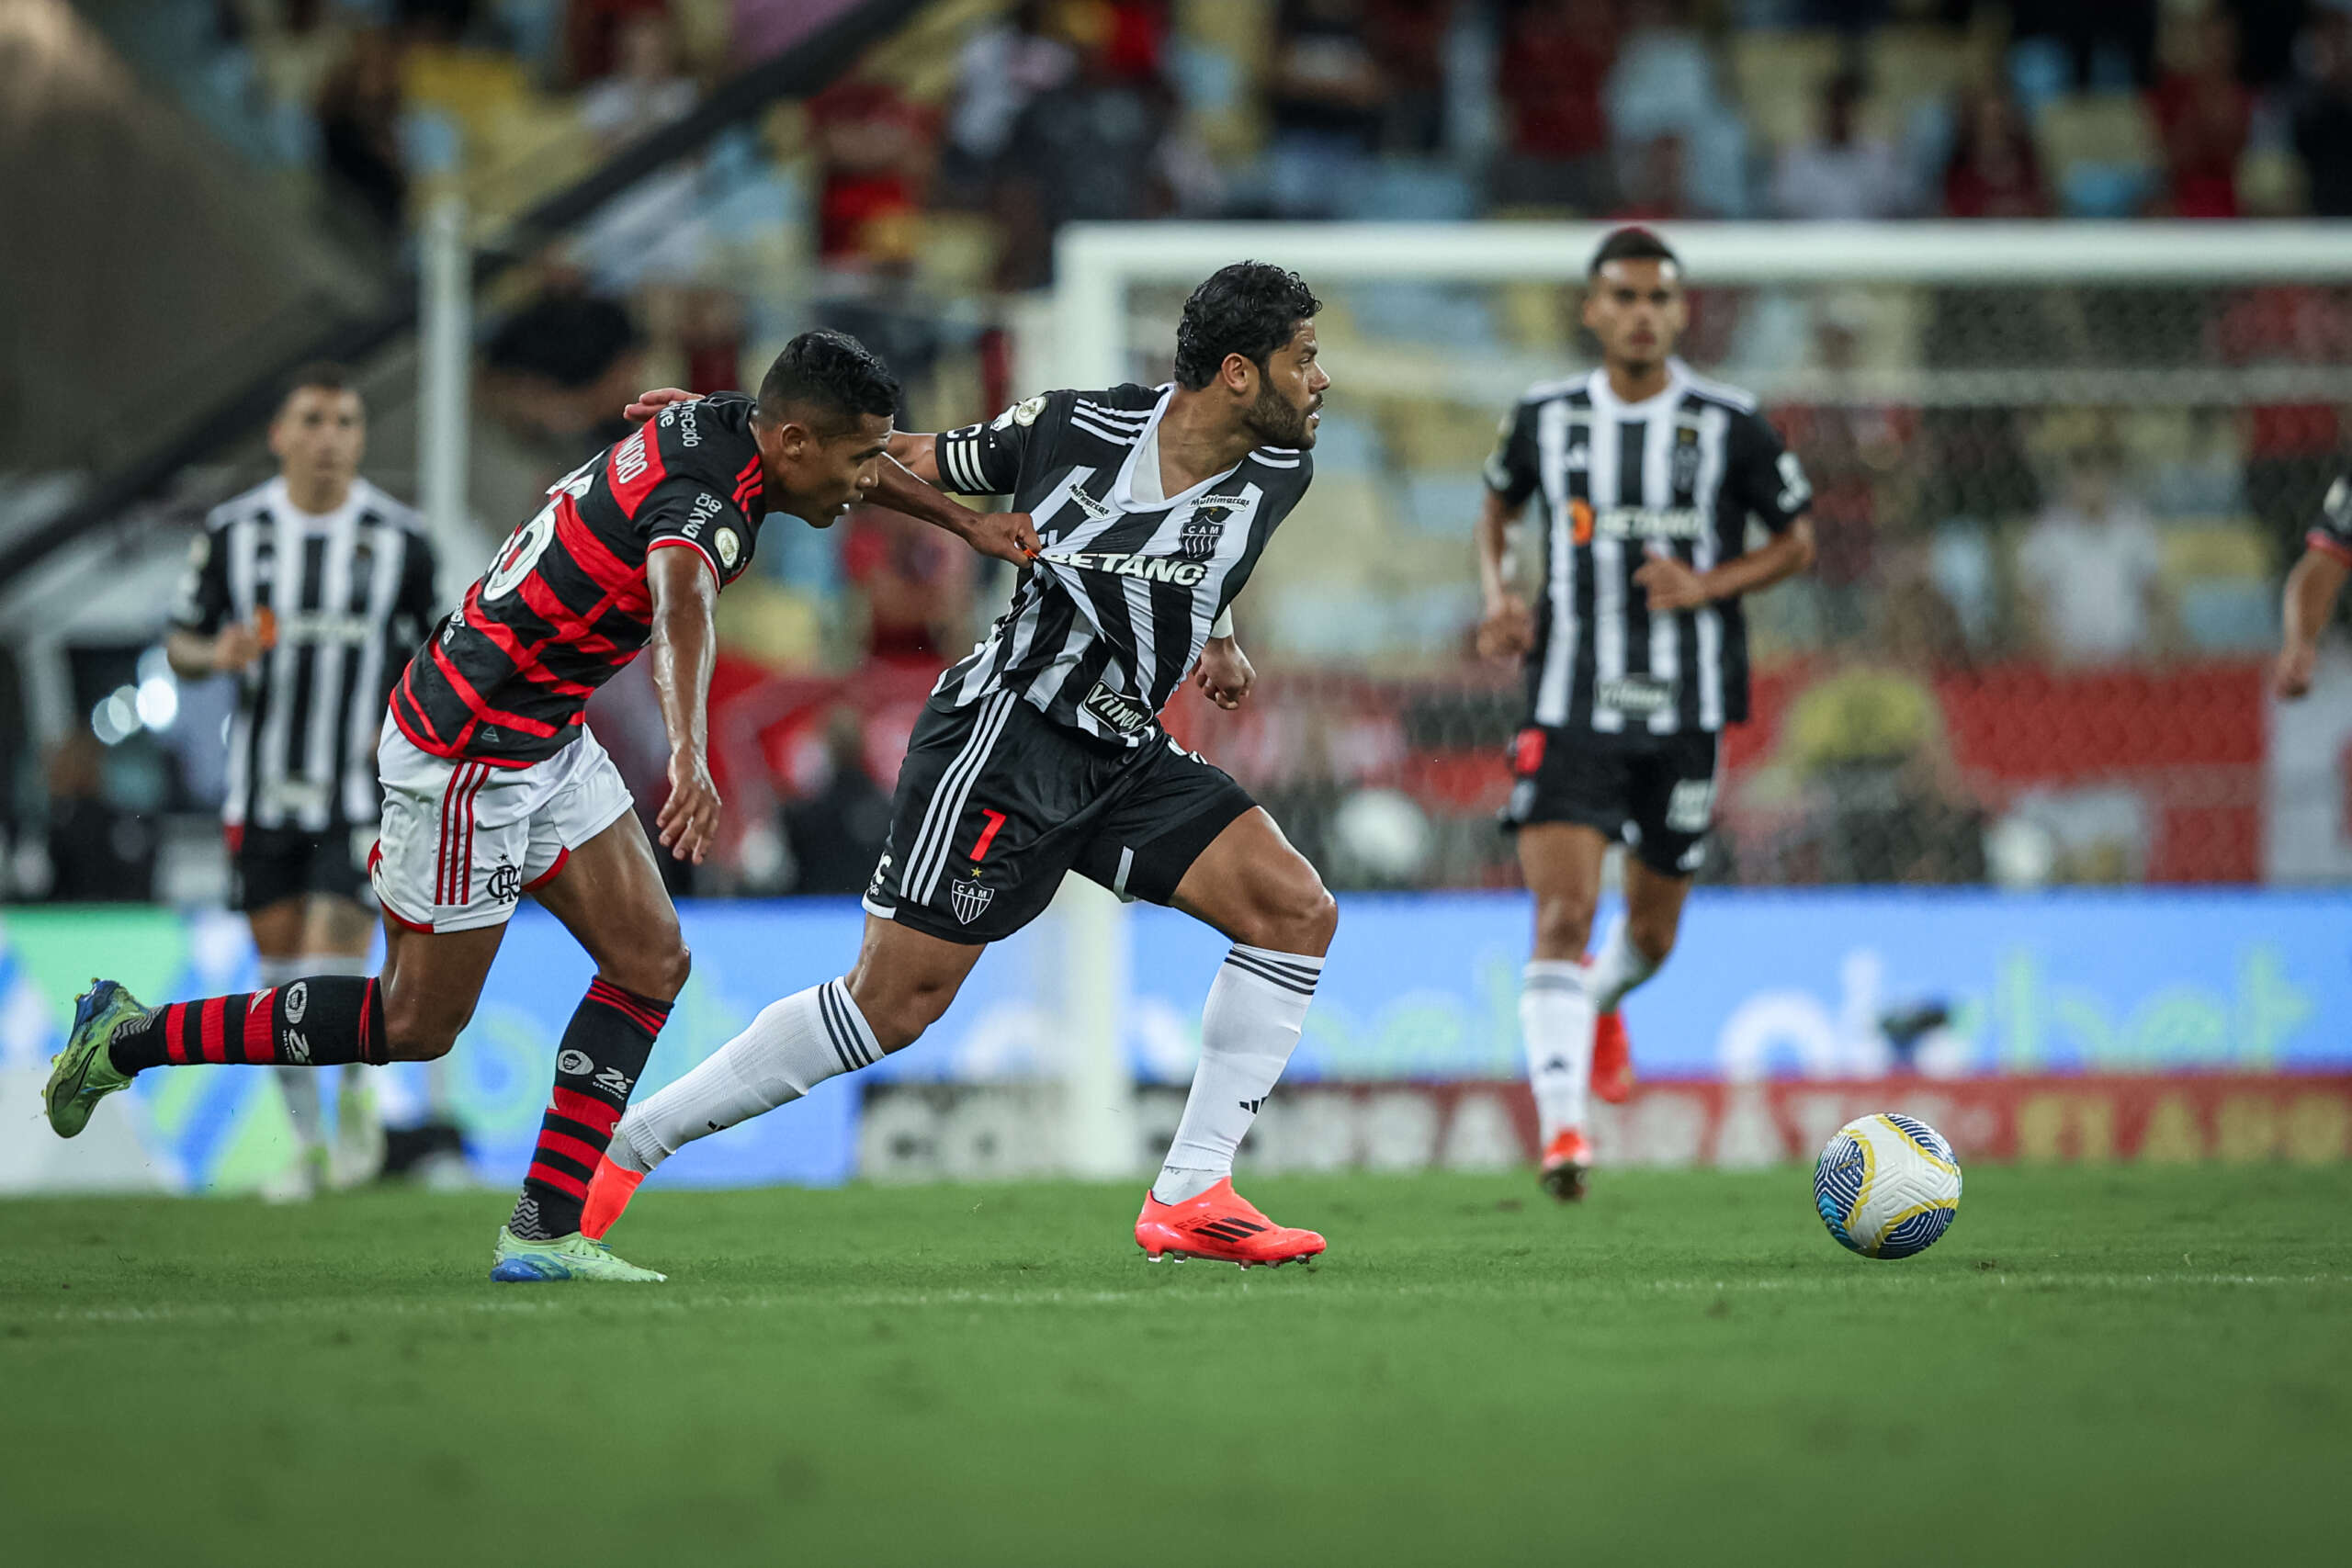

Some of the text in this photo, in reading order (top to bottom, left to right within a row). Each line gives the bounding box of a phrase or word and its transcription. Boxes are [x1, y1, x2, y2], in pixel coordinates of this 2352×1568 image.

[1190, 496, 1250, 507] Multimarcas
[969, 808, 1007, 862] 7
[956, 884, 989, 898] CAM
[594, 1066, 635, 1093] Zé
